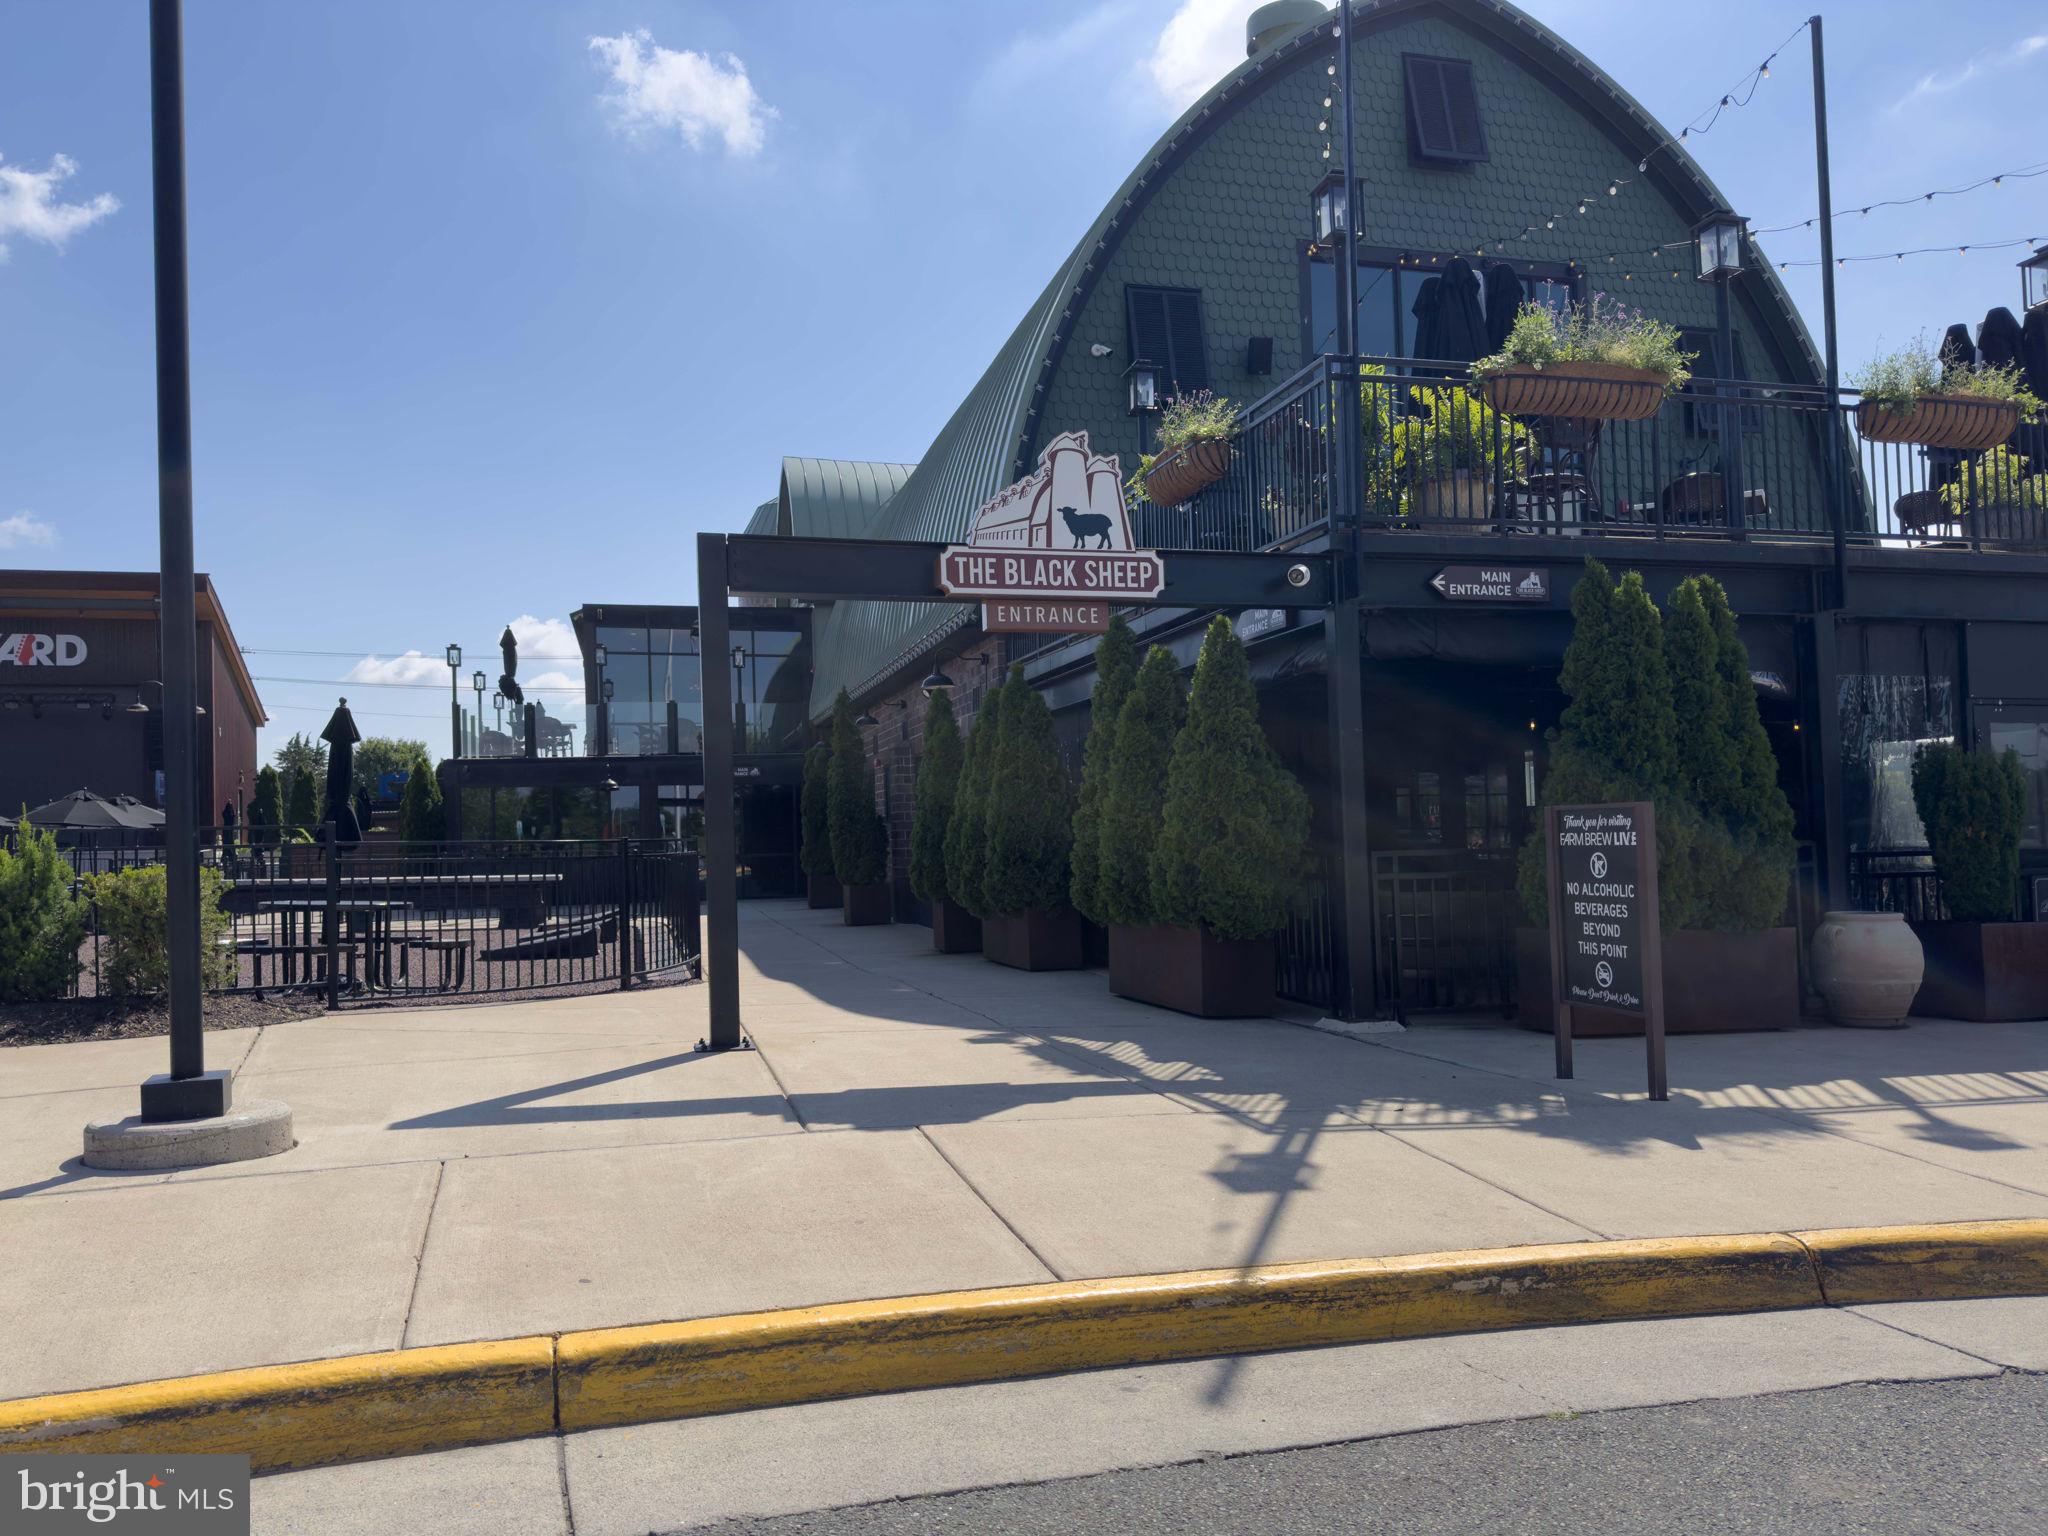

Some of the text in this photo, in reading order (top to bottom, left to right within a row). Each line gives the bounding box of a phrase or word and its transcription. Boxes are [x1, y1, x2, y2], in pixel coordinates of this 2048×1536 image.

[954, 557, 1152, 588] THE BLACK SHEEP
[1481, 571, 1511, 582] MAIN
[1449, 584, 1512, 596] ENTRANCE
[997, 606, 1098, 624] ENTRANCE
[1254, 609, 1268, 620] MAIN
[0, 633, 88, 666] ARD
[1564, 814, 1632, 831] Thank you for visiting
[1614, 831, 1637, 846] LIVE
[1566, 882, 1634, 898] NO ALCOHOLIC
[1574, 902, 1628, 918] BEVERAGES
[1583, 922, 1620, 938] BEYOND
[1578, 941, 1628, 958] THIS POINT
